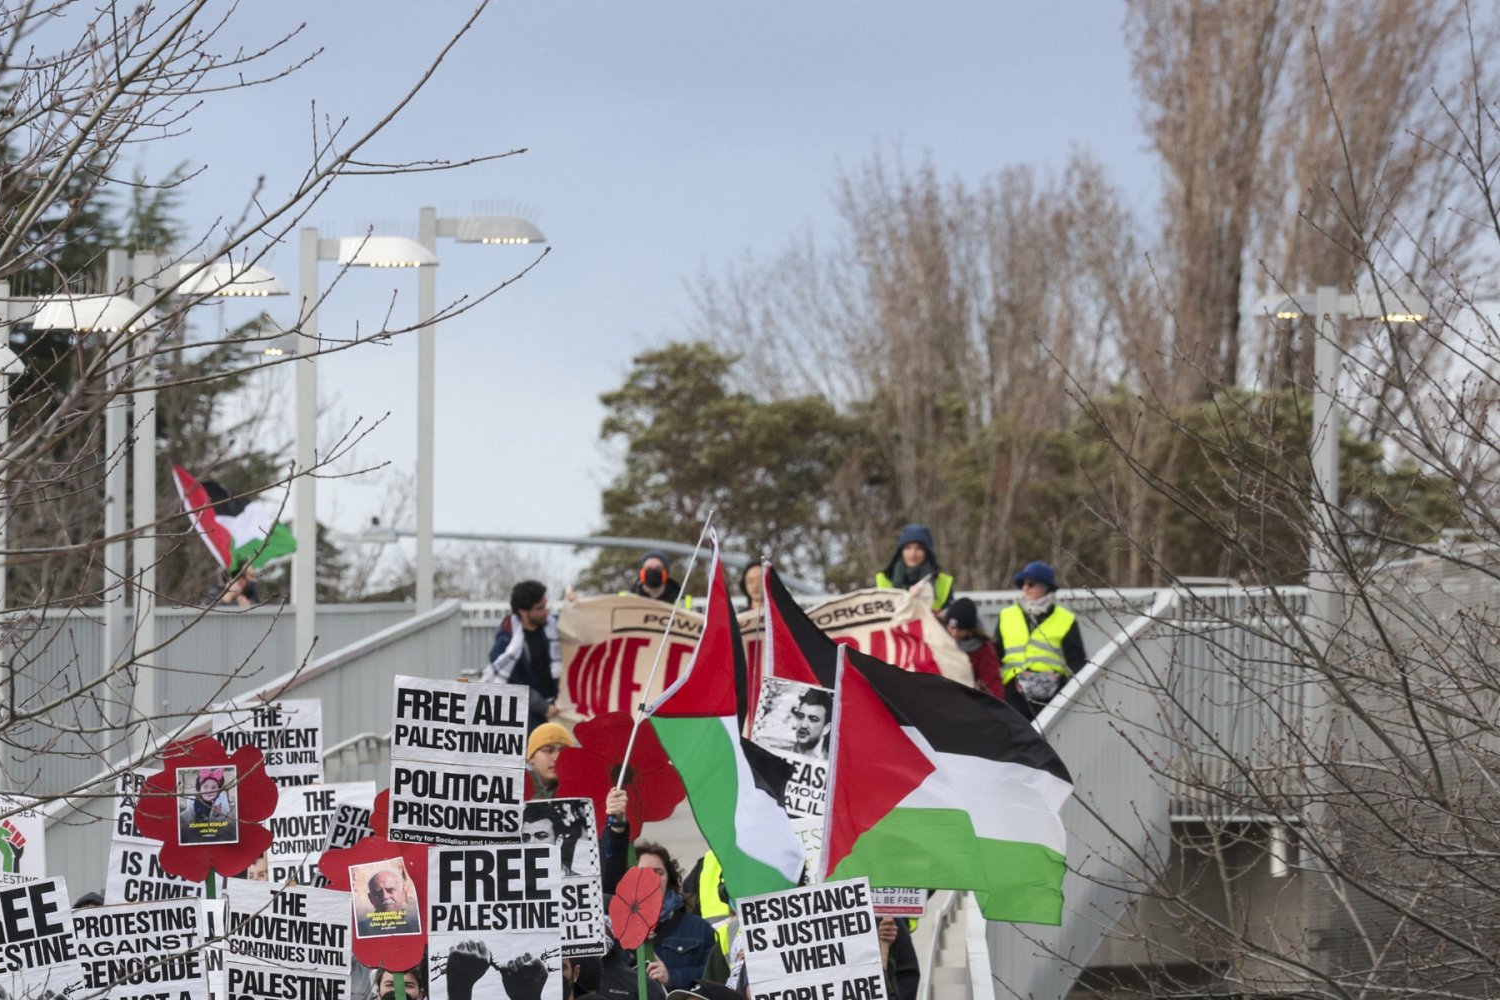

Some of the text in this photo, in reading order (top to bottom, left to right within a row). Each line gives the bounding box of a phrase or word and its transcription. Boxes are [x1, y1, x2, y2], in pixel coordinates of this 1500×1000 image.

[253, 708, 282, 727] THE
[396, 688, 524, 728] FREE ALL
[217, 727, 318, 751] MOVEMENT
[394, 724, 524, 756] PALESTINIAN
[286, 750, 319, 765] UNTIL
[303, 790, 336, 812] THE
[394, 767, 520, 805] POLITICAL
[392, 800, 520, 833] PRISONERS
[424, 834, 434, 842] for
[121, 851, 143, 876] IS
[439, 848, 552, 903] FREE
[270, 890, 307, 917] THE
[740, 883, 868, 926] RESISTANCE
[883, 896, 895, 904] BE
[897, 896, 920, 905] FREE
[72, 906, 197, 940] PROTESTING
[230, 911, 348, 948] MOVEMENT
[431, 902, 560, 932] PALESTINE
[746, 910, 872, 952] IS JUSTIFIED
[78, 933, 198, 958] AGAINST
[229, 939, 305, 964] CONTINUES
[309, 949, 347, 967] UNTIL
[571, 946, 604, 956] Liberation
[780, 942, 847, 974] WHEN
[82, 951, 201, 989] GENOCIDE
